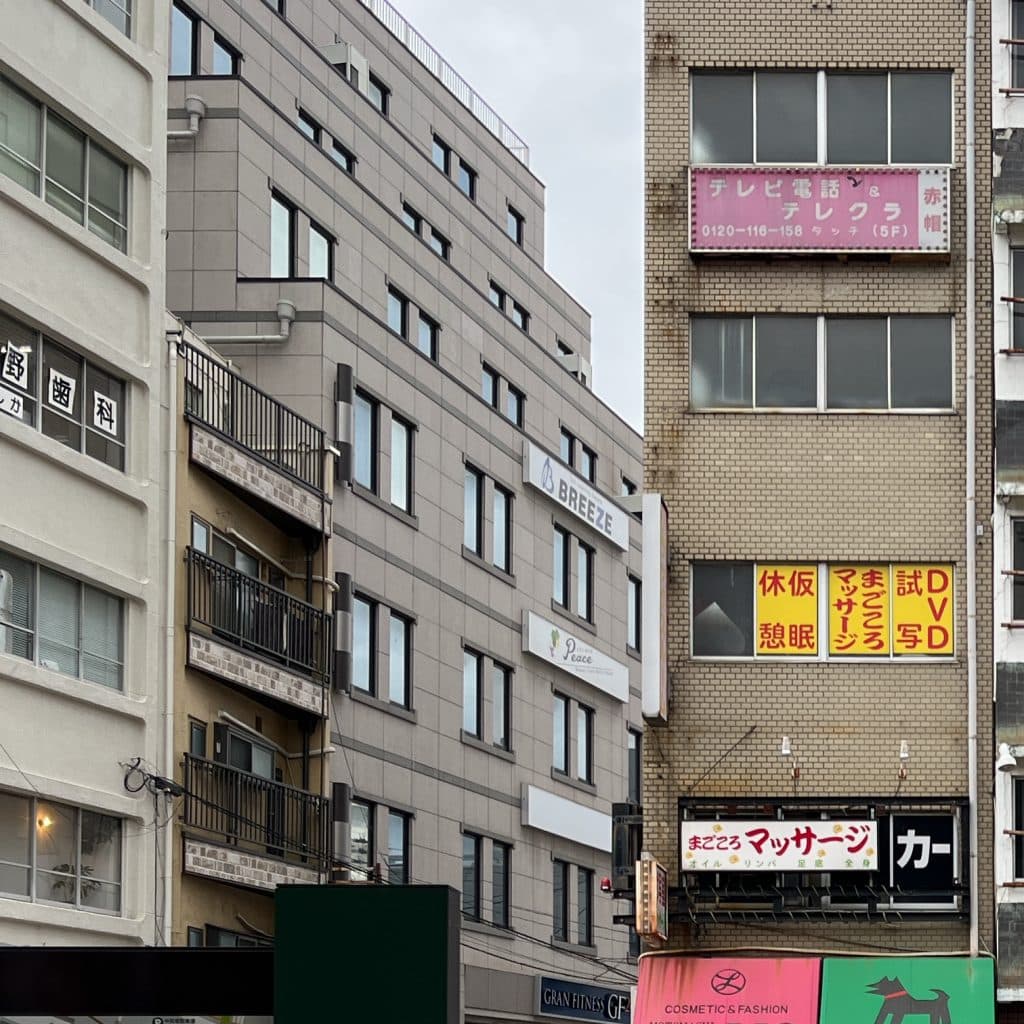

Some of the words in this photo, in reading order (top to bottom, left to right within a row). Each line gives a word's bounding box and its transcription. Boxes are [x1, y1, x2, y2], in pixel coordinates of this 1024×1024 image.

[709, 178, 839, 198] テレビ電話
[868, 186, 880, 198] &
[781, 202, 901, 220] テレクラ
[872, 224, 908, 238] (5F)
[557, 478, 613, 536] BREEZE
[758, 570, 785, 649] 休憩
[788, 570, 815, 649] 仮眠
[833, 569, 857, 651] マッサージ
[861, 569, 884, 649] まごころ
[896, 570, 922, 649] 試写
[927, 569, 949, 649] DVD
[563, 637, 593, 664] Peace
[688, 834, 741, 851] まごころ
[744, 824, 871, 857] マッサージ
[688, 859, 722, 868] オイル
[544, 988, 570, 1007] GRAN
[572, 991, 605, 1012] FITNESS
[665, 1004, 725, 1014] COSMETIC
[728, 1004, 736, 1014] &
[738, 1004, 788, 1014] FASHION
